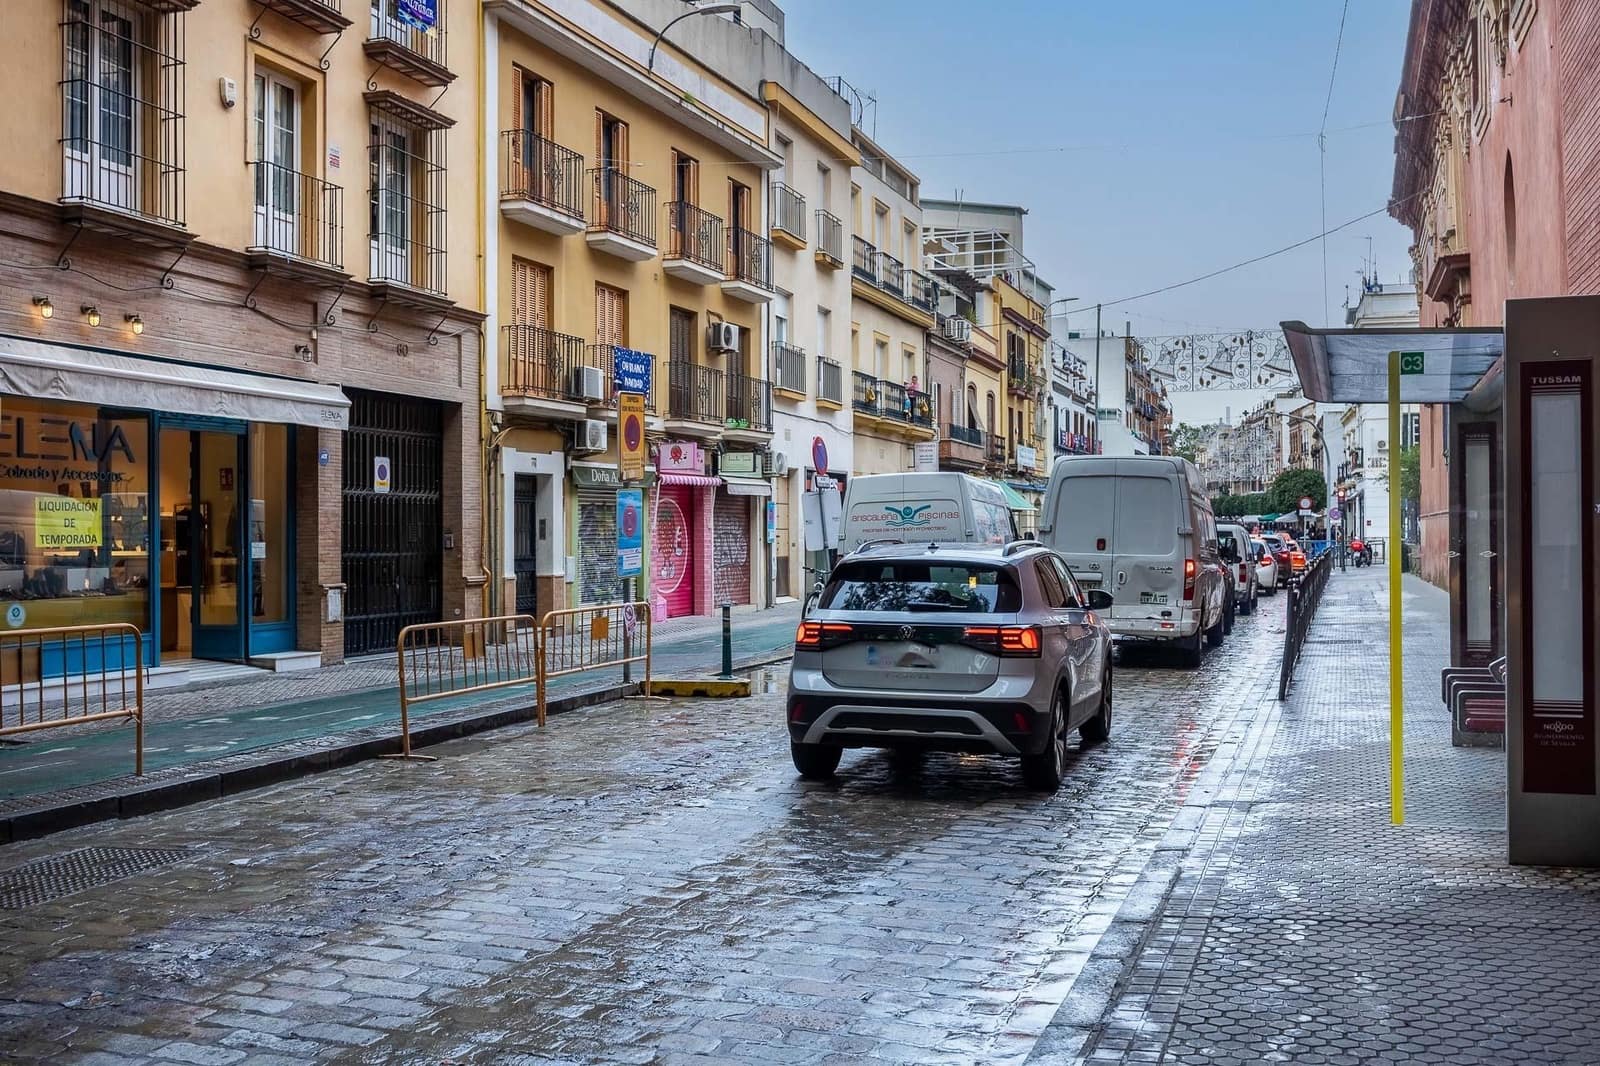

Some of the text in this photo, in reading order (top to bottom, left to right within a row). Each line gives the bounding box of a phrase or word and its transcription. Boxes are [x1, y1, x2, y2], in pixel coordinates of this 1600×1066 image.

[1401, 356, 1423, 371] C3
[1530, 375, 1582, 384] TUSSAM
[320, 409, 343, 420] ELENA
[51, 468, 60, 482] y
[591, 468, 610, 482] Doña
[38, 500, 98, 512] LIQUIDACIÓN
[63, 518, 76, 528] DE
[40, 534, 98, 545] TEMPORADA
